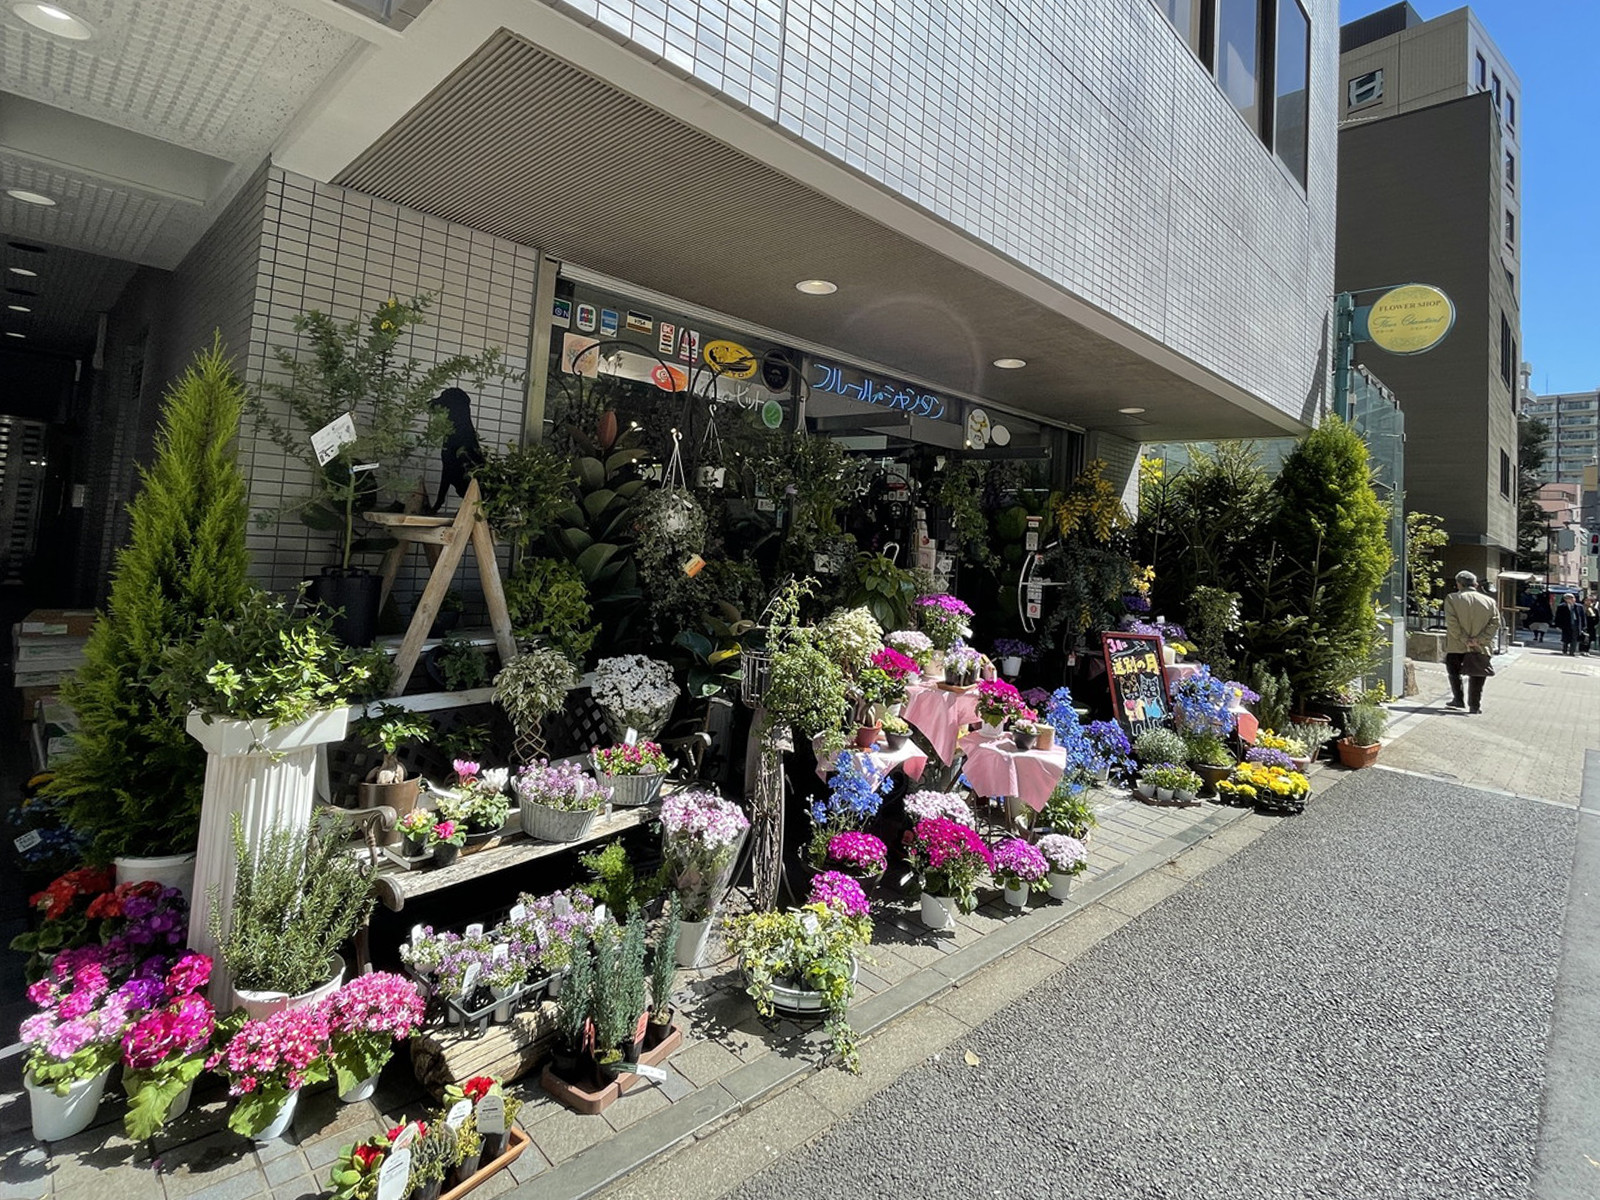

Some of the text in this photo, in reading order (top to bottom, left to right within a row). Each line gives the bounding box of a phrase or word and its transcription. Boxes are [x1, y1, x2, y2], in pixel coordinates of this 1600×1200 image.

[1379, 300, 1441, 312] FLOWER SHOP
[634, 318, 646, 326] VISA
